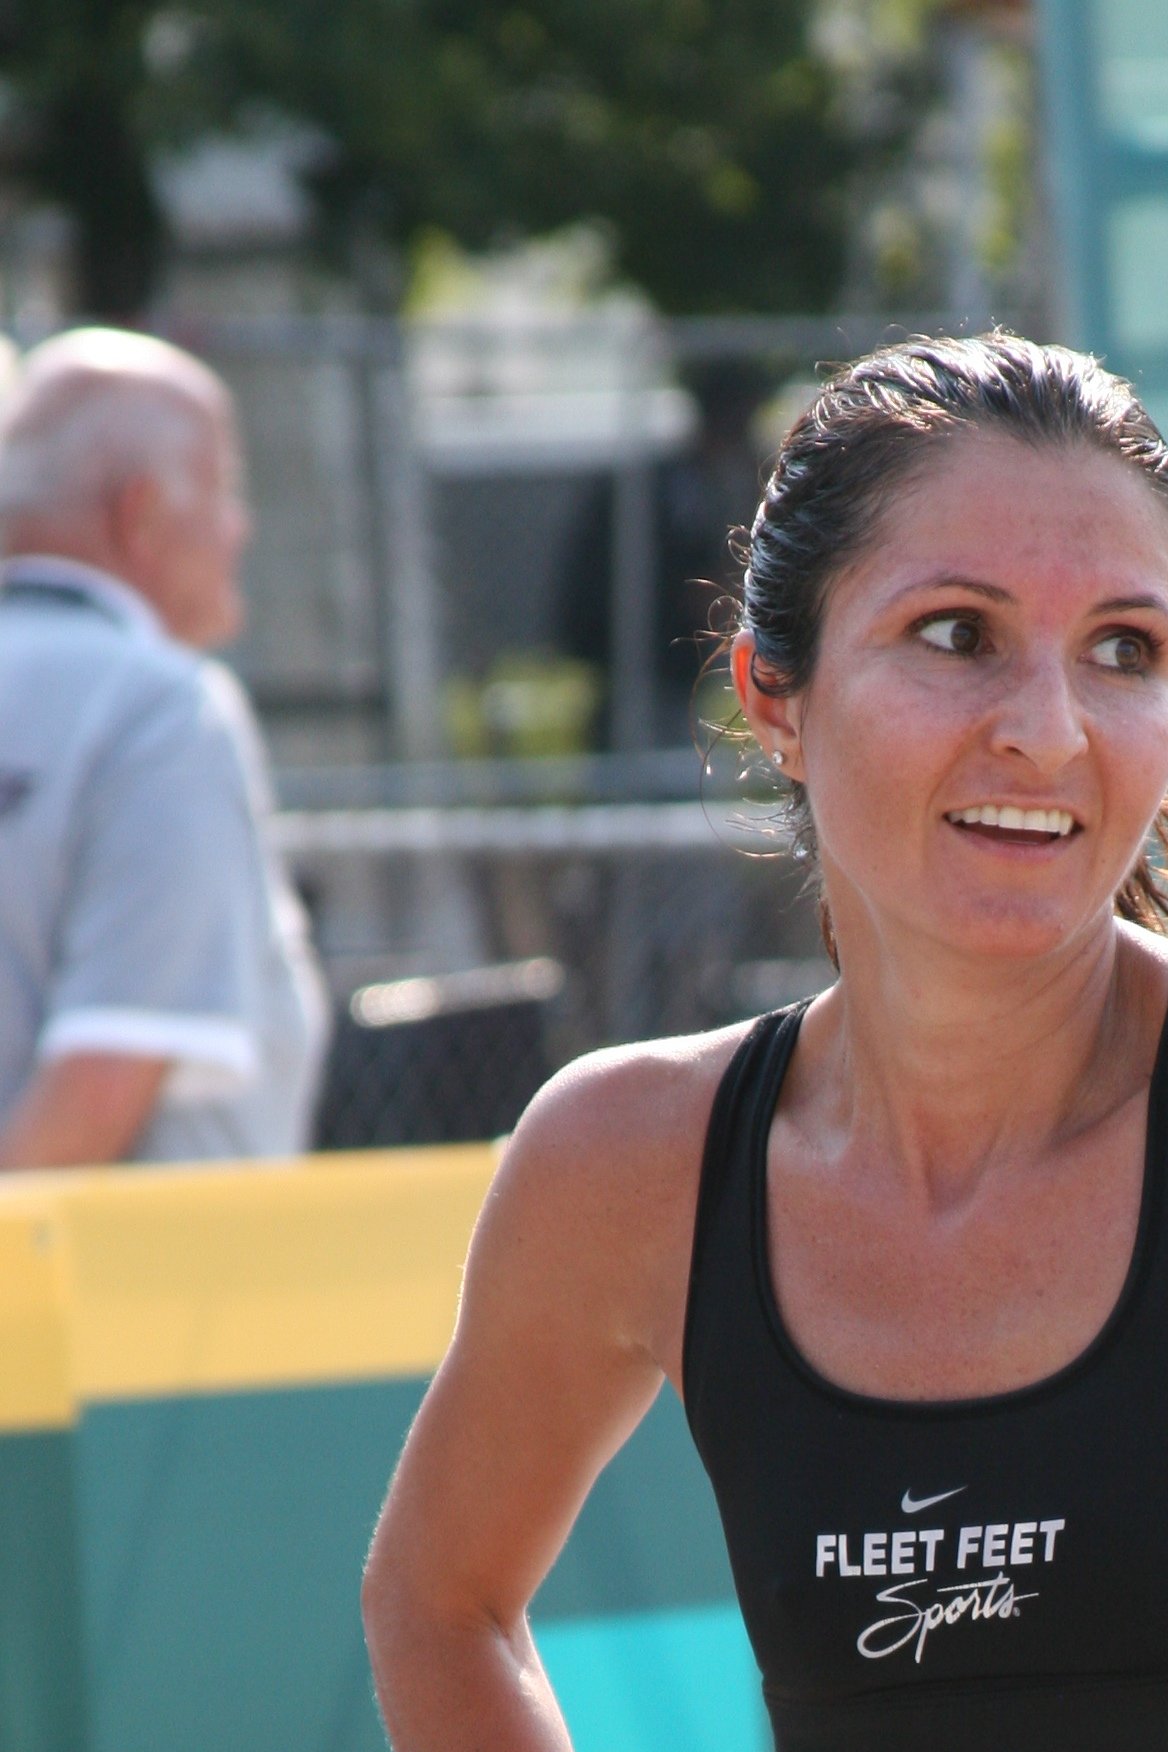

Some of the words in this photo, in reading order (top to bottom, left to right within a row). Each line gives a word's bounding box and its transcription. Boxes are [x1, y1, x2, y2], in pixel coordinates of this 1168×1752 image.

[816, 1529, 944, 1577] FLEET
[957, 1518, 1066, 1569] FEET
[857, 1571, 1039, 1663] Sports
